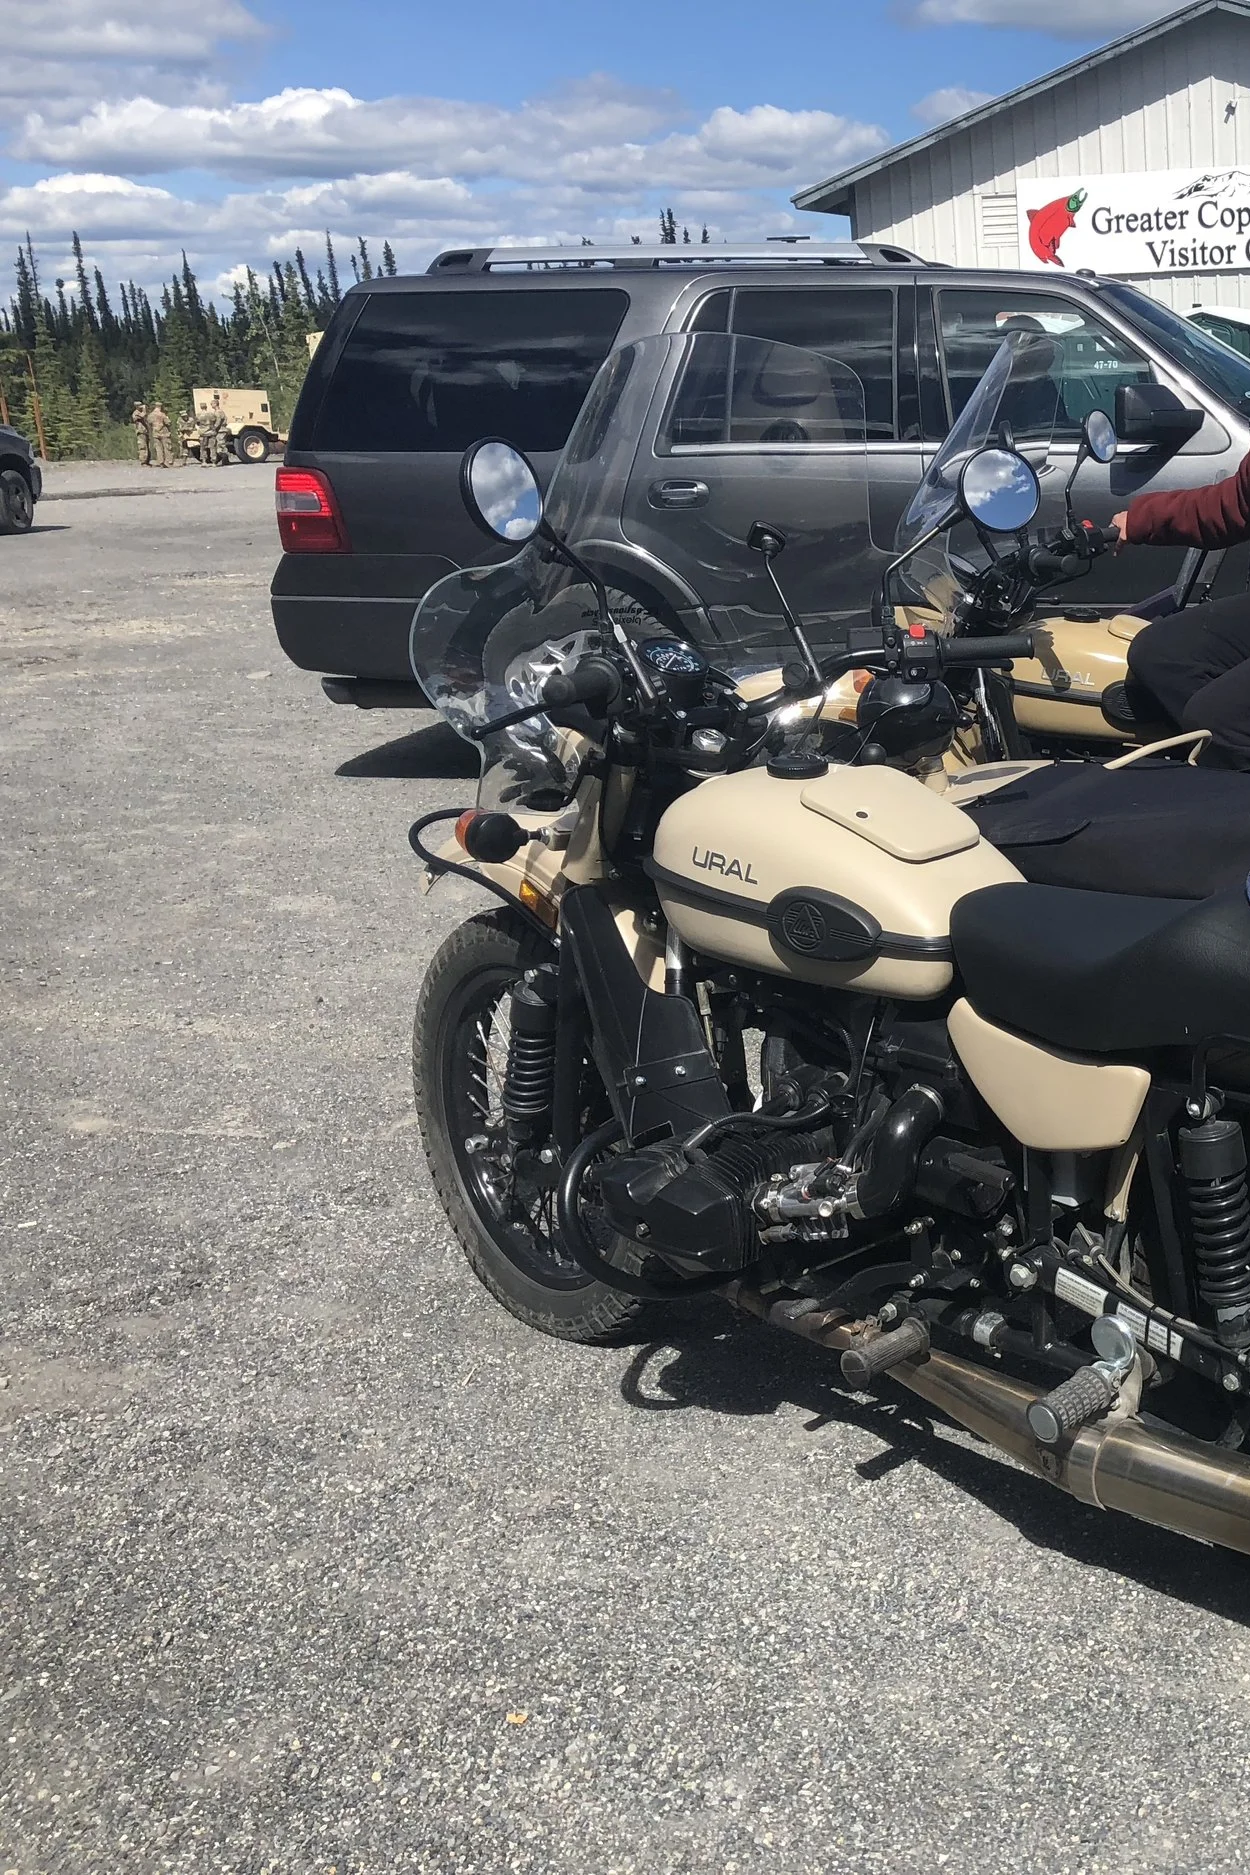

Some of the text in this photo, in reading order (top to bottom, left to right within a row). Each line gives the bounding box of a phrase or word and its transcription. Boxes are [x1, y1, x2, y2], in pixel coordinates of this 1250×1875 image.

[1091, 206, 1190, 235] Greater
[1145, 238, 1237, 268] Visitor
[1041, 668, 1095, 686] URAL
[691, 846, 758, 885] URAL
